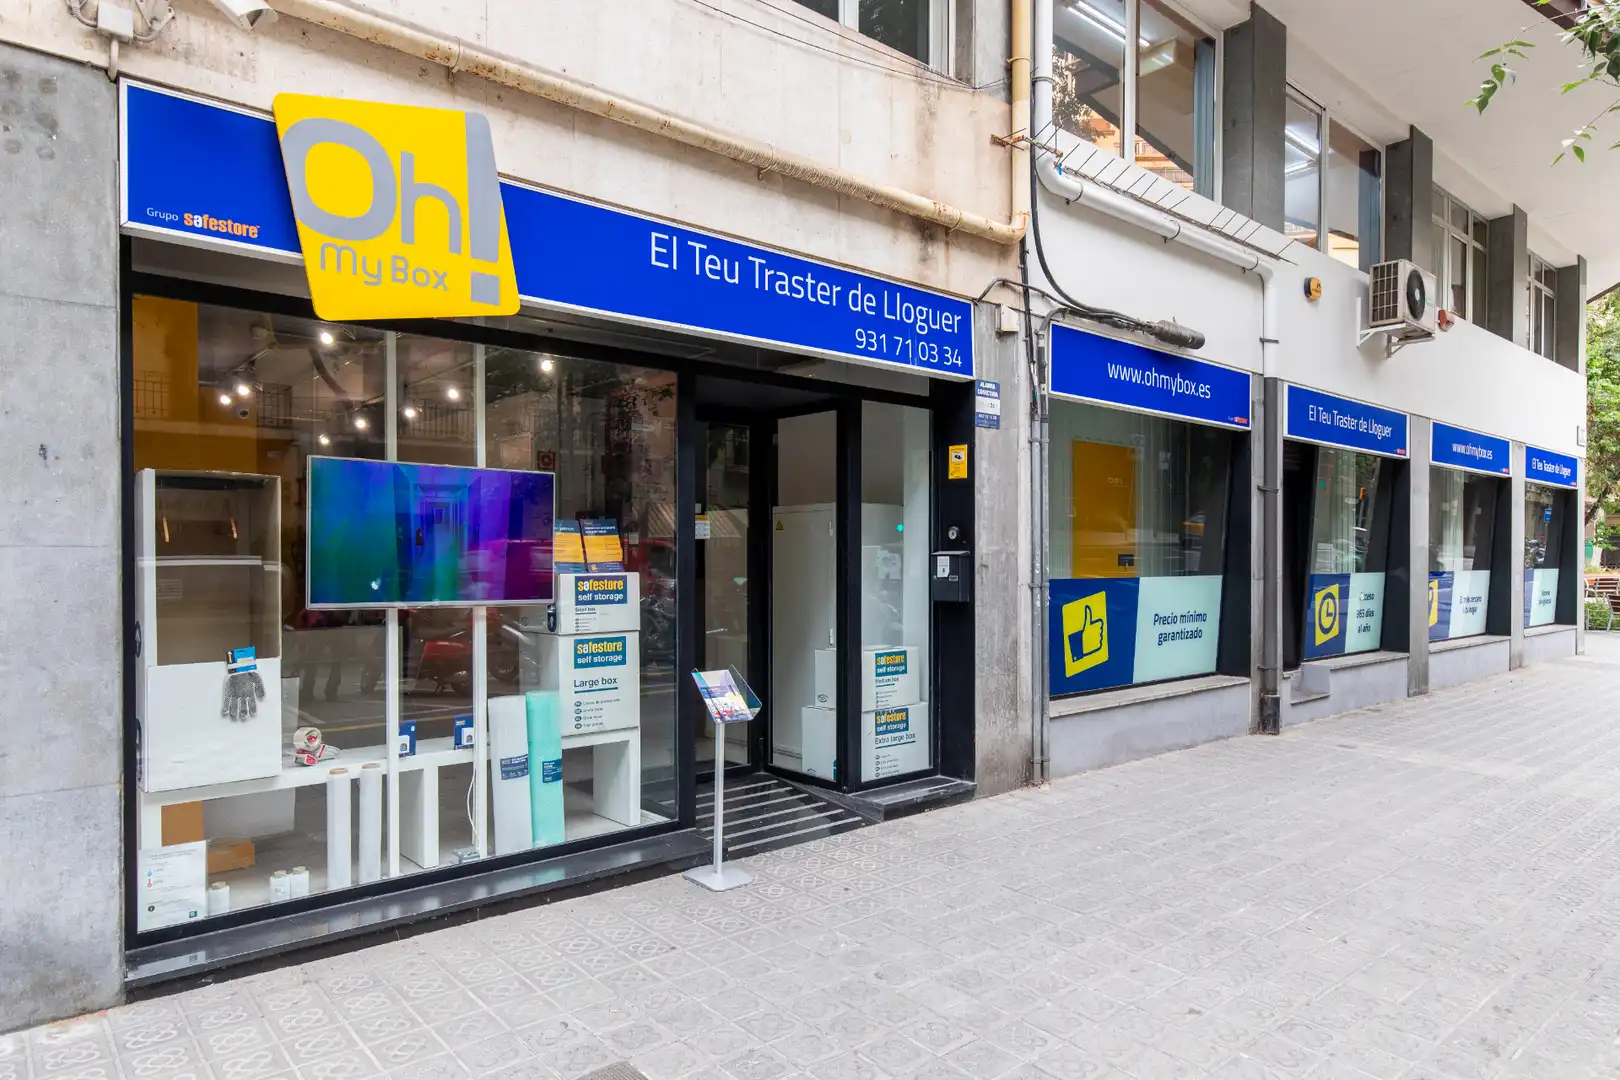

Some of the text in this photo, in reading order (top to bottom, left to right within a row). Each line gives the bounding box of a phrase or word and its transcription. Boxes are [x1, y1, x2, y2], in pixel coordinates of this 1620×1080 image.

[146, 207, 260, 239] Grupo safestore
[392, 255, 449, 292] Box
[650, 231, 962, 335] El Teu Traster de Lloguer
[855, 328, 962, 368] 931 71 03 34
[1107, 361, 1211, 399] www.ohmybox.es
[1308, 404, 1392, 440] El Teu Traster de Lloguer
[577, 579, 624, 591] safestore
[578, 592, 624, 601] self storage
[1153, 611, 1208, 626] Precio mínimo
[1157, 627, 1203, 646] garantizado
[576, 640, 623, 655] safestore
[577, 654, 623, 664] self storage
[574, 676, 617, 688] Large box
[876, 712, 906, 724] safestore
[877, 722, 906, 732] self storage
[875, 736, 890, 745] Extra
[890, 734, 904, 744] large
